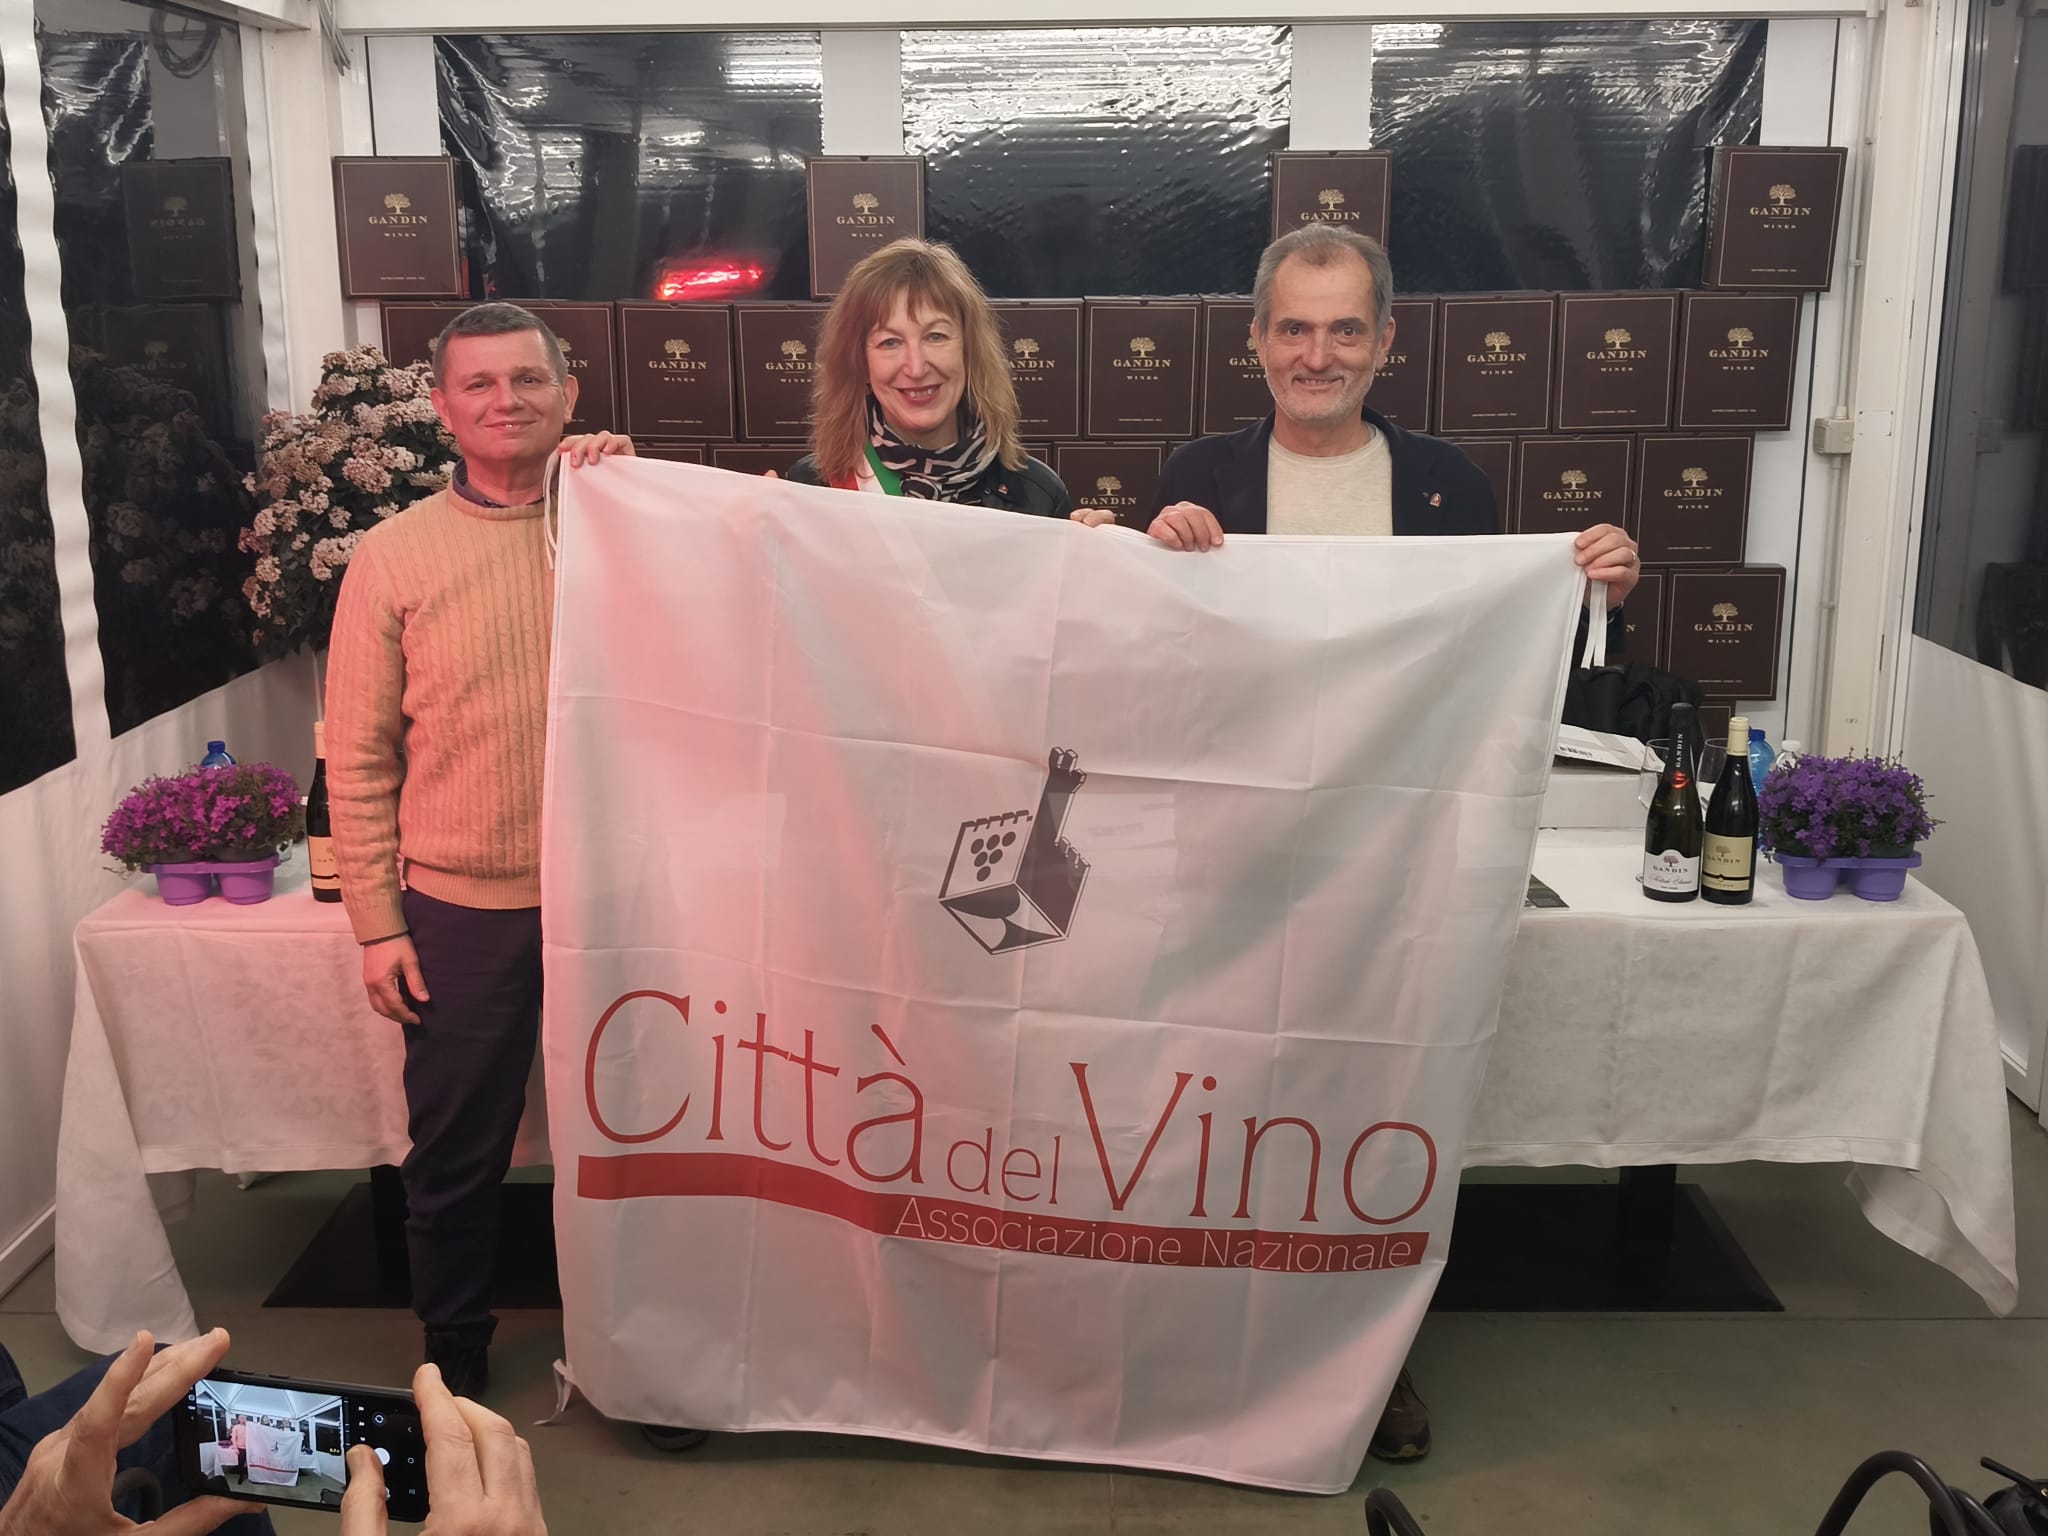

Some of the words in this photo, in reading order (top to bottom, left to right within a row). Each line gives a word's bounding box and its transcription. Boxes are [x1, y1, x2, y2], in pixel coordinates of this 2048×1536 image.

[1300, 211, 1360, 221] GANDIN
[1749, 207, 1811, 216] GANDIN
[368, 215, 428, 224] GANDIN
[836, 215, 895, 224] GANDIN
[1467, 352, 1527, 363] GANDIN
[1586, 350, 1647, 360] GANDIN
[1708, 348, 1769, 358] GANDIN
[648, 360, 708, 370] GANDIN
[1009, 360, 1056, 369] ANDIN
[1112, 358, 1171, 368] GANDIN
[1543, 490, 1603, 500] GANDIN
[1663, 488, 1723, 498] GANDIN
[1080, 497, 1137, 505] GANDIN
[1694, 623, 1754, 632] GANDIN
[1675, 733, 1684, 768] GANDIN
[584, 989, 925, 1184] Città
[946, 1126, 1061, 1205] del
[1068, 1062, 1438, 1226] Vino
[893, 1196, 1182, 1265] Associazione
[1200, 1230, 1412, 1272] Nazionale
